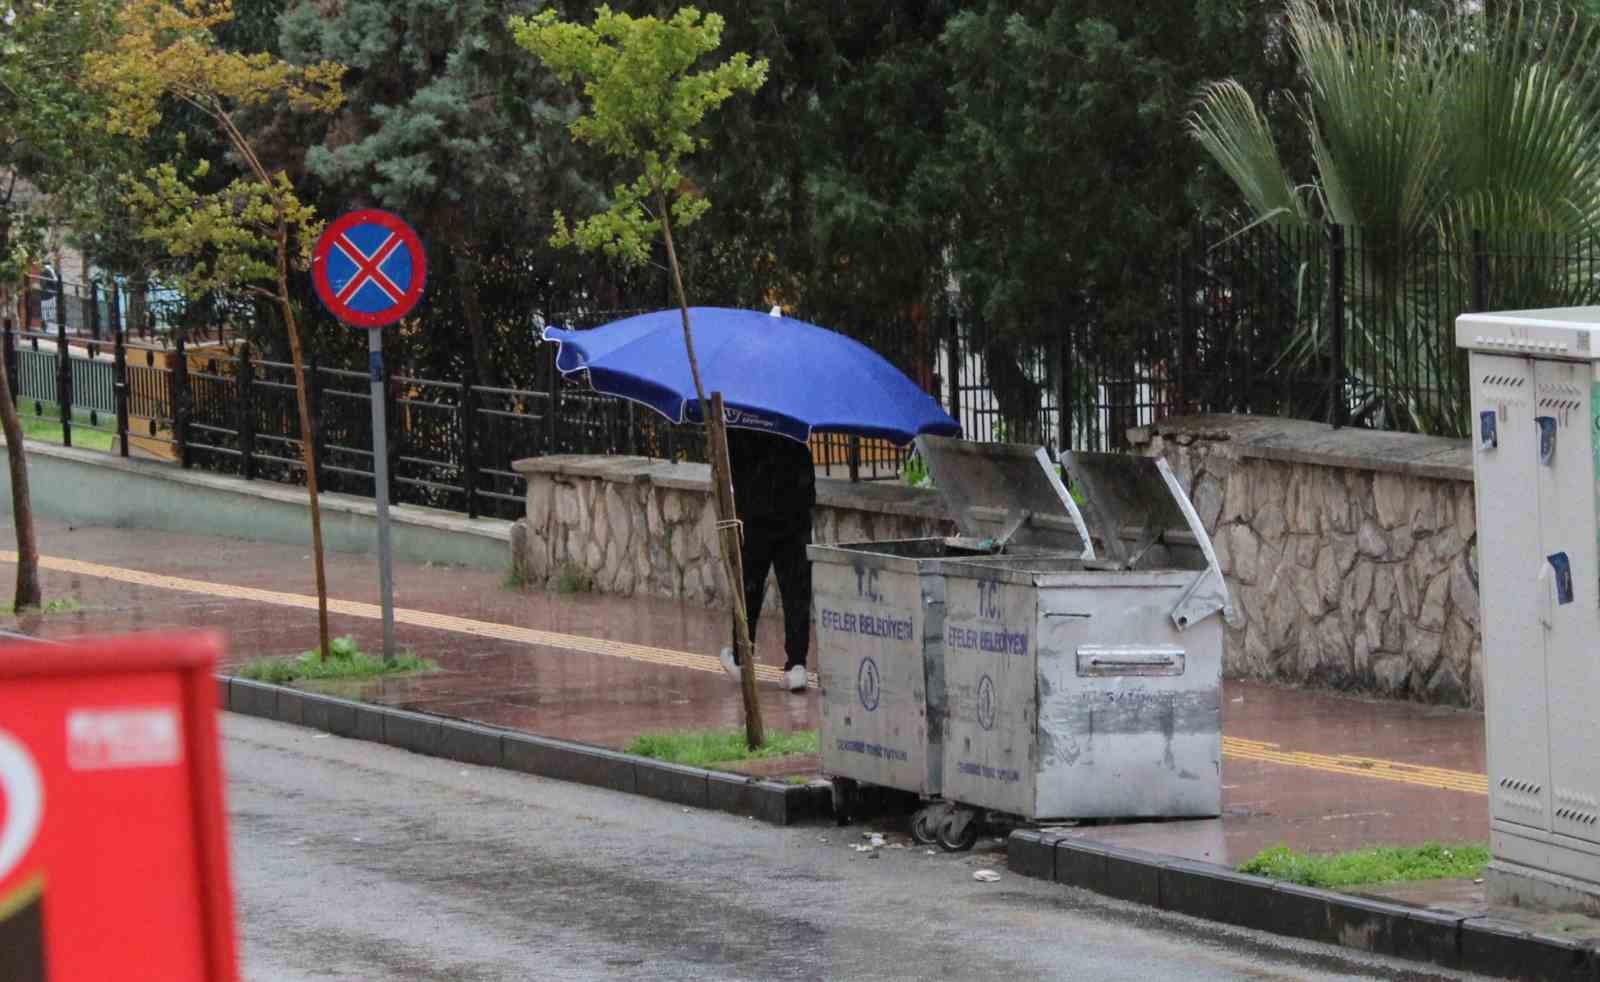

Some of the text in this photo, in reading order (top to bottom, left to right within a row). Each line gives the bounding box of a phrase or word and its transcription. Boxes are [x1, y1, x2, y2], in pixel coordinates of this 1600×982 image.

[854, 560, 883, 602] T.C.
[977, 577, 1001, 620] T.C.
[821, 610, 857, 632] EFELER
[949, 625, 978, 650] EFELER
